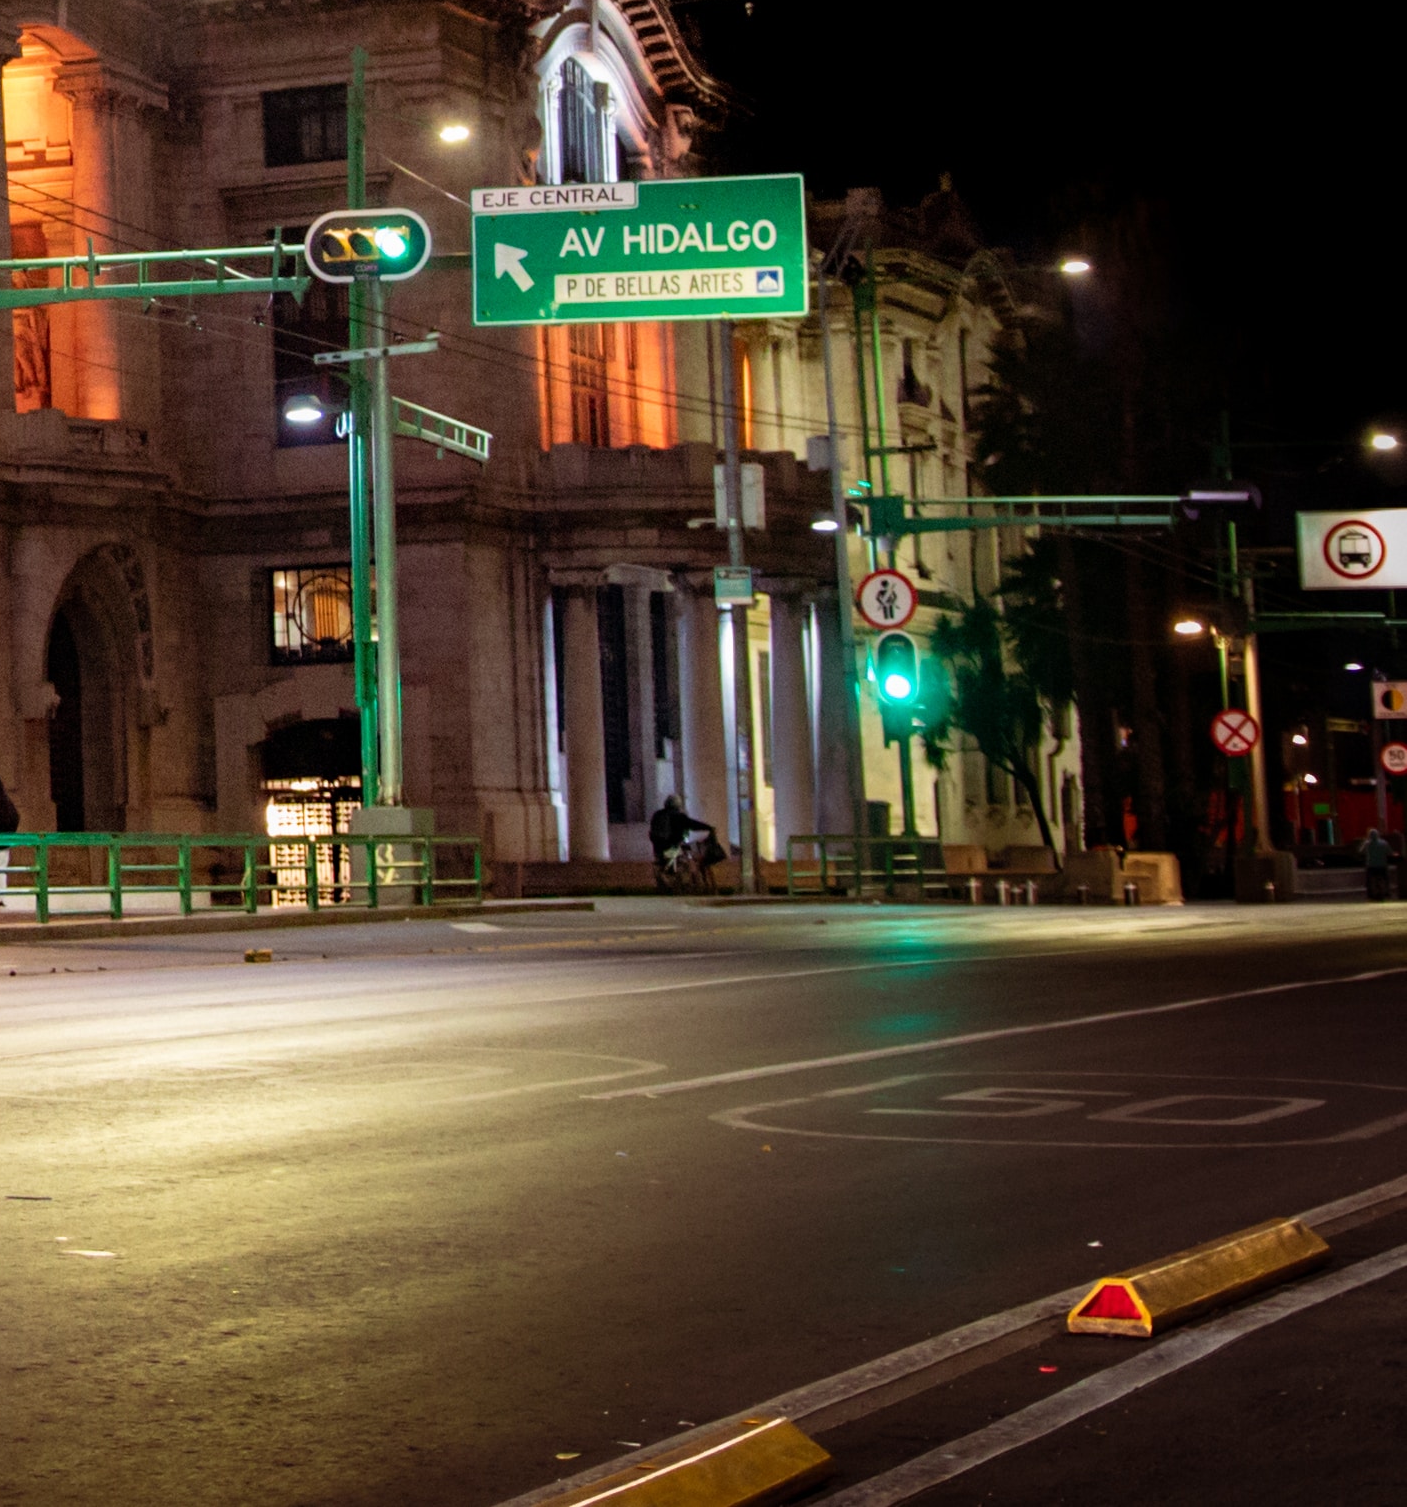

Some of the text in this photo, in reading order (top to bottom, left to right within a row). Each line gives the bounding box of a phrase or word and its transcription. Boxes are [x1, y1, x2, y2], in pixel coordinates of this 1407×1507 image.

[482, 188, 623, 208] EJE CENTRAL
[559, 219, 777, 258] AV HIDALGO
[567, 273, 744, 297] P DE BELLAS ARTES
[1389, 749, 1405, 761] 50
[863, 1088, 1327, 1126] 50
